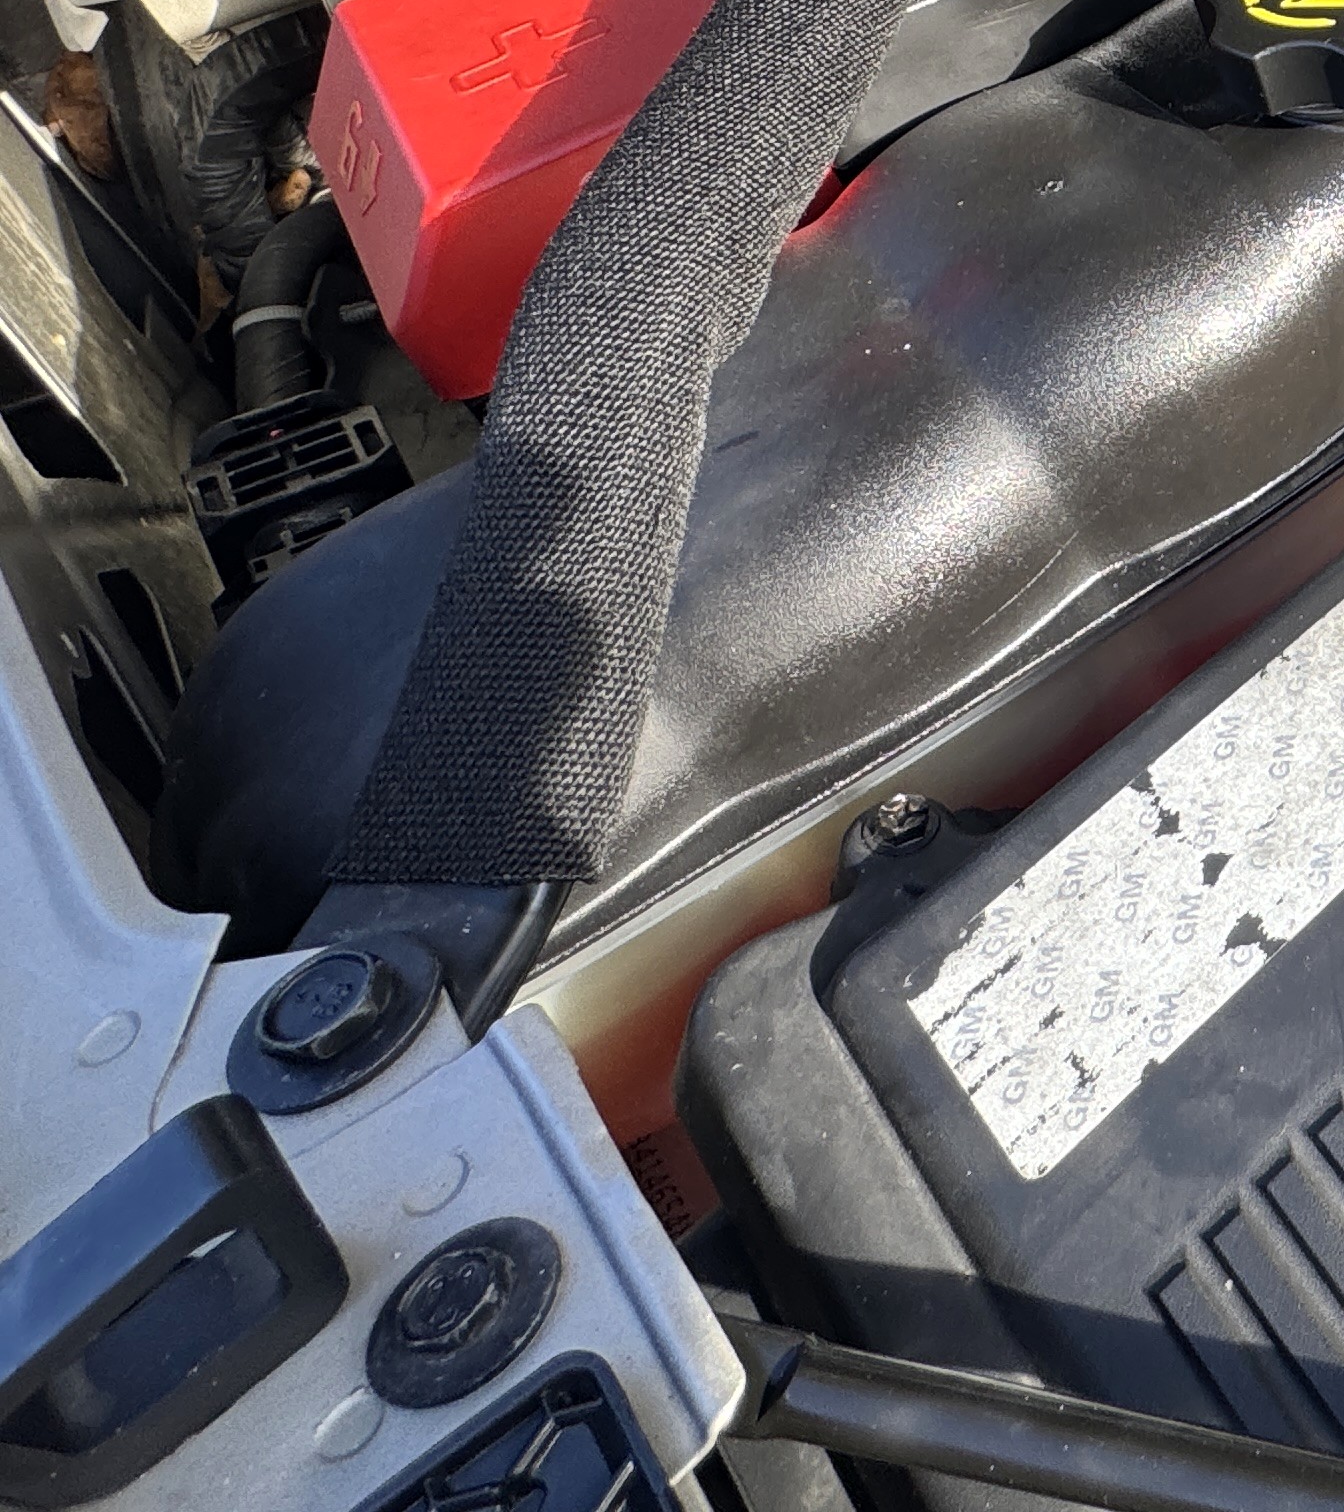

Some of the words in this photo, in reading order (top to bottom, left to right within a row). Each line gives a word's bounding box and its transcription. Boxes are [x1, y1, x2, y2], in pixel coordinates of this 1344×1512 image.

[1213, 715, 1243, 761] GM
[1268, 734, 1298, 780] GM
[1059, 848, 1091, 900] GM
[1115, 871, 1147, 923] GM
[981, 906, 1016, 957] GM
[1173, 892, 1202, 945] GM
[1031, 944, 1064, 1000] GM
[1091, 970, 1123, 1023] GM
[952, 1004, 987, 1060] GM
[1150, 991, 1183, 1046] GM
[1003, 1045, 1037, 1104] GM
